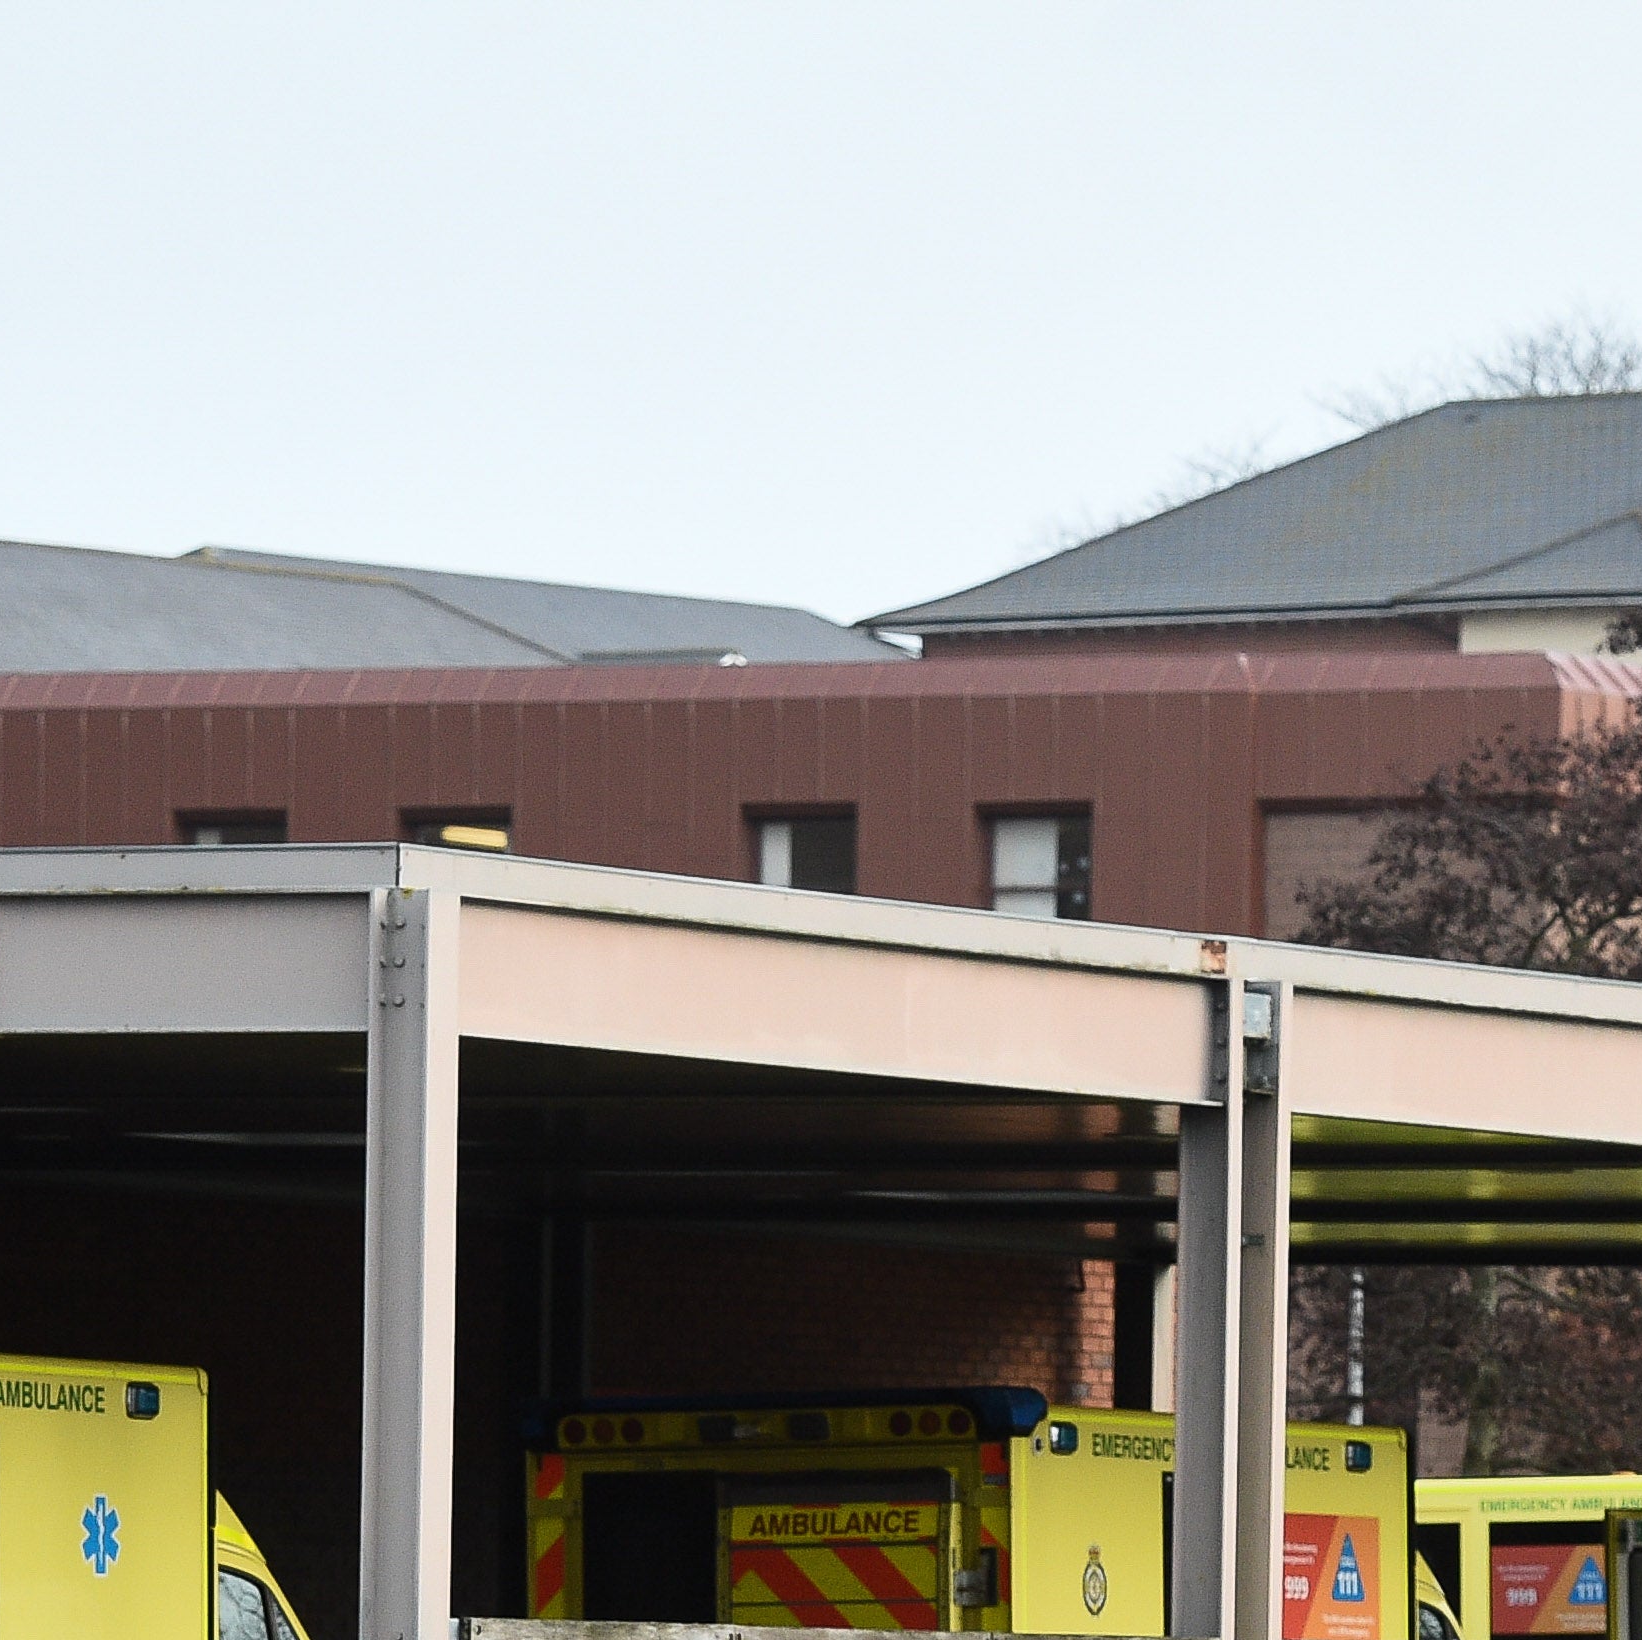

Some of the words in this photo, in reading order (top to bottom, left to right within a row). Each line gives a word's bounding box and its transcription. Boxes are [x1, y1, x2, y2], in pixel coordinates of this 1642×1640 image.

[1091, 1433, 1175, 1462] EMERGENC
[1481, 1498, 1565, 1512] EMERGENCY
[748, 1510, 920, 1536] AMBULANCE
